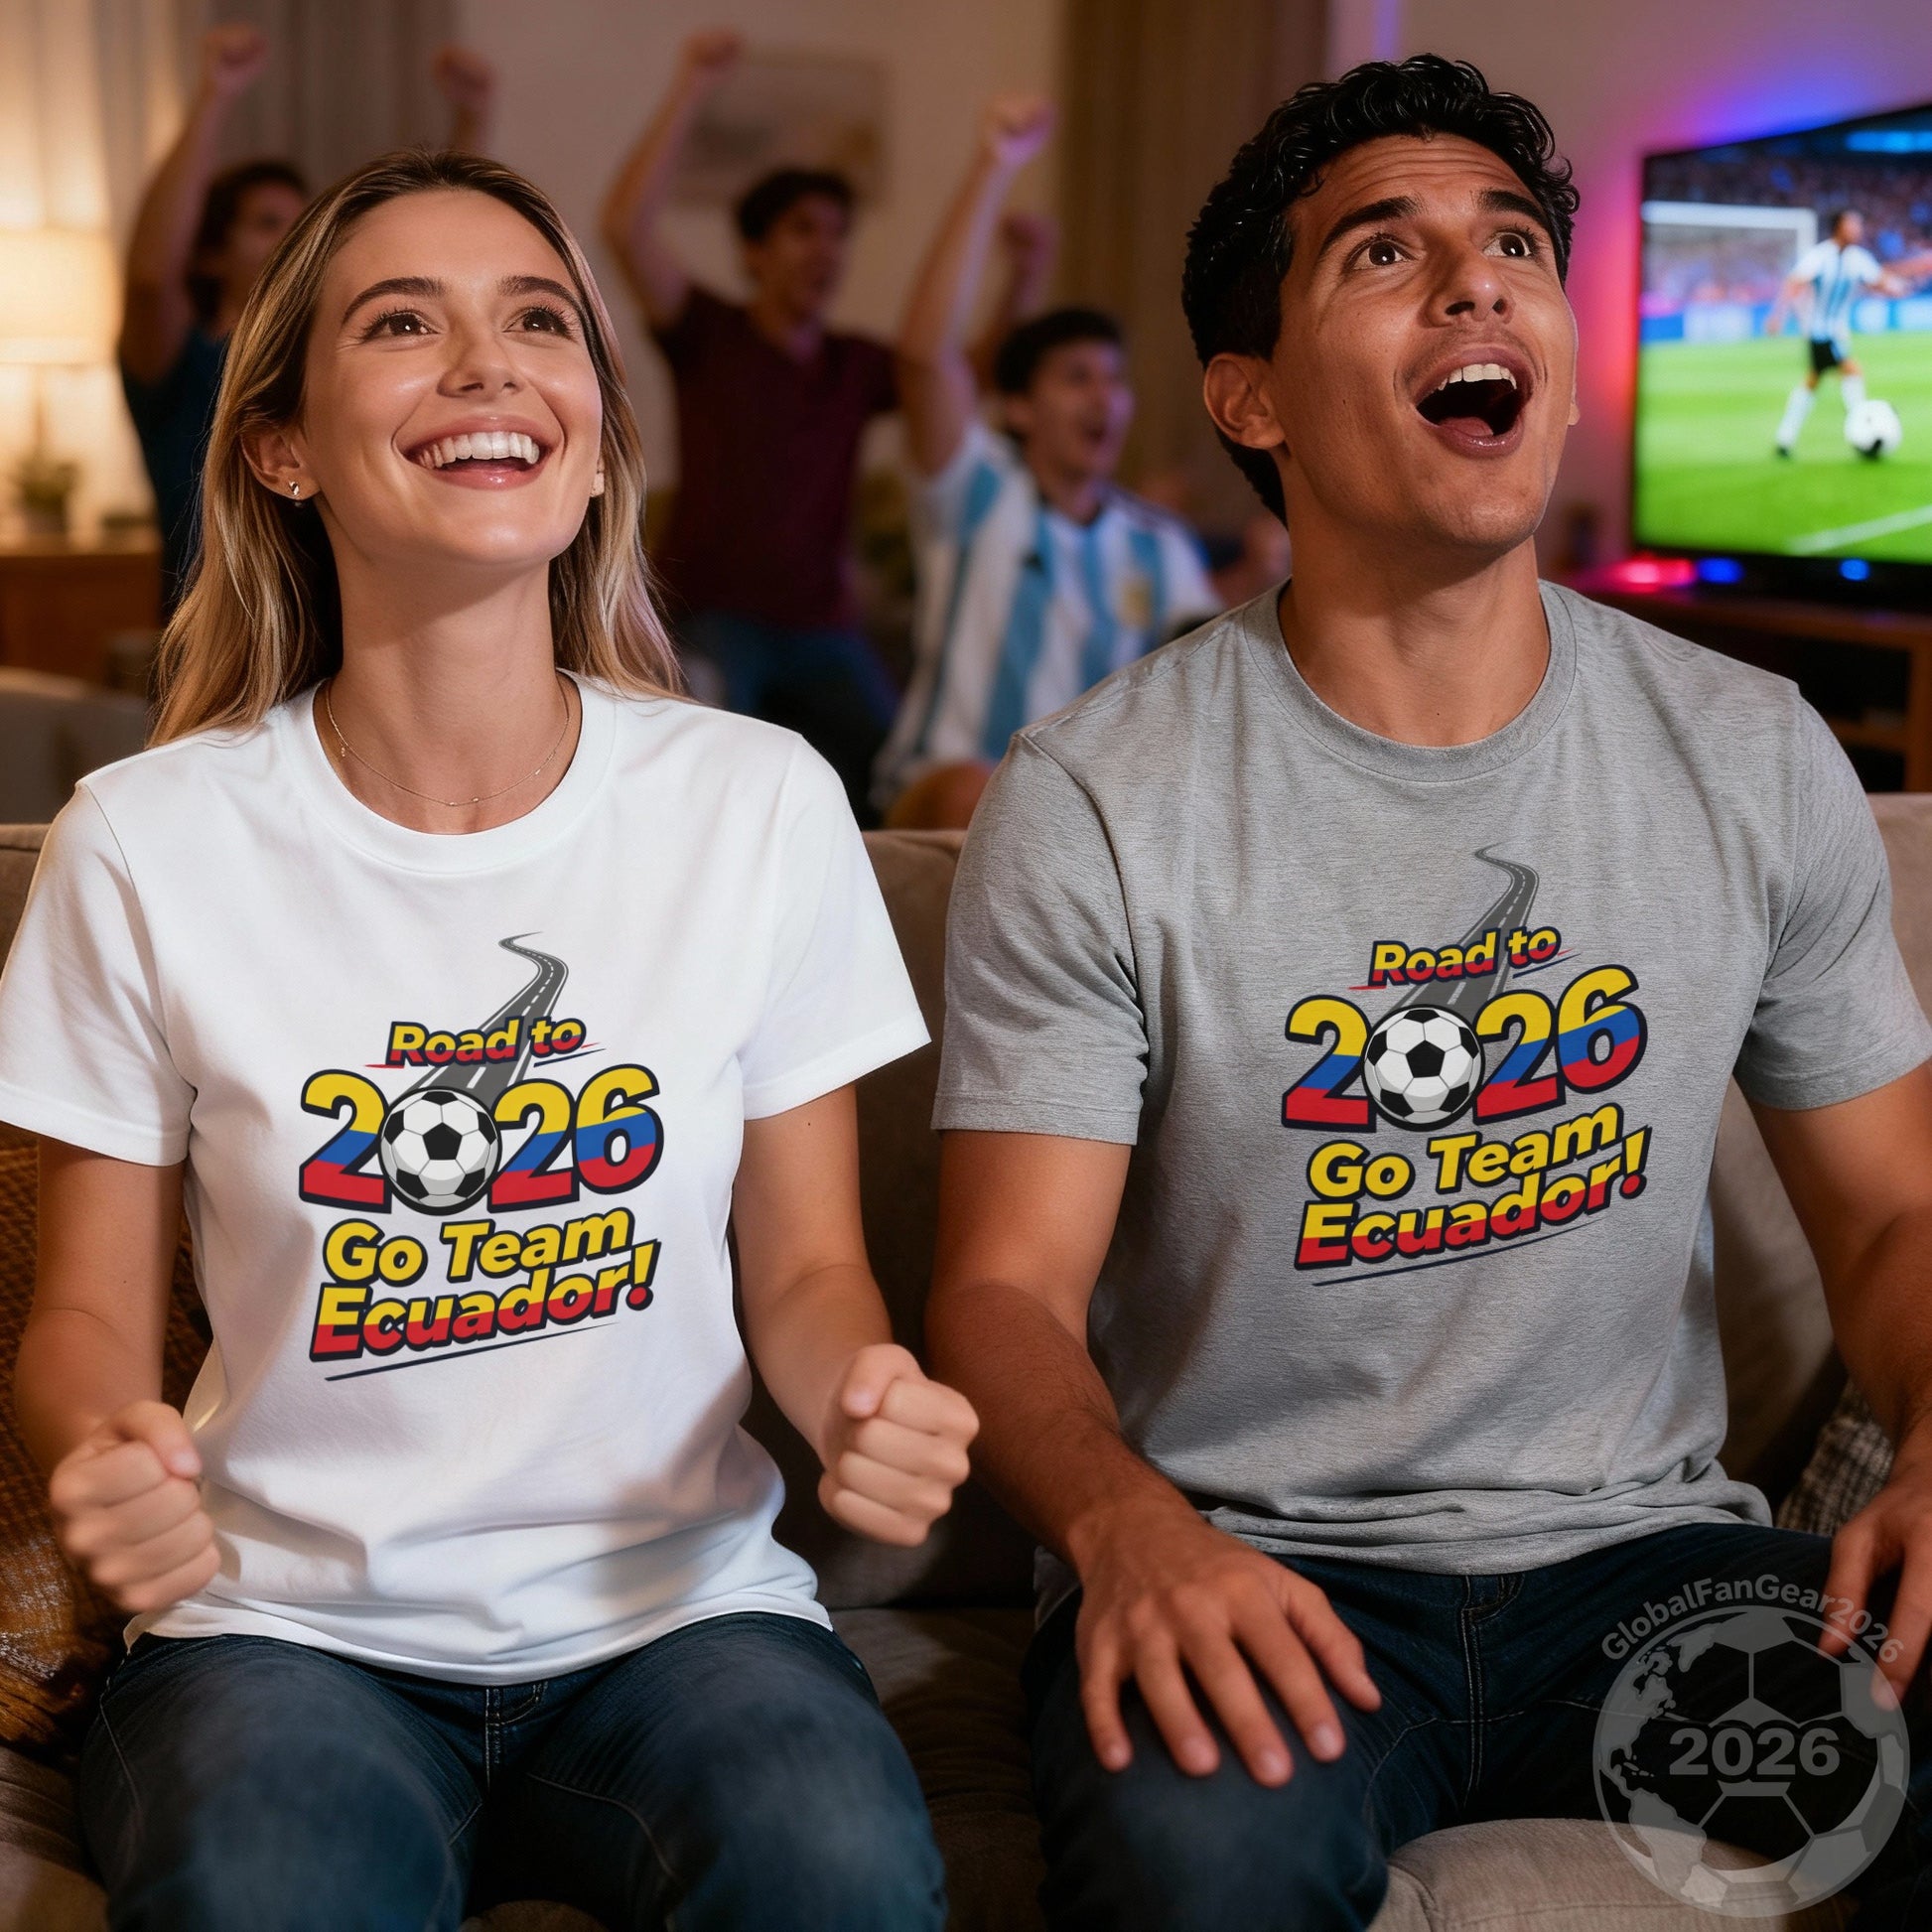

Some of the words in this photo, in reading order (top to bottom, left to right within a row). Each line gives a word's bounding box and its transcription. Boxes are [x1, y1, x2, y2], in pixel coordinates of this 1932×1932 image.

[1368, 928, 1501, 987] Road
[1508, 925, 1562, 968] to
[385, 1016, 521, 1067] Road
[529, 1017, 587, 1057] to
[1307, 1140, 1415, 1200] Go
[1427, 1103, 1624, 1195] Team
[1295, 1125, 1652, 1270] Ecuador!
[323, 1218, 428, 1287] Go
[440, 1206, 634, 1282] Team
[309, 1239, 661, 1362] Ecuador!
